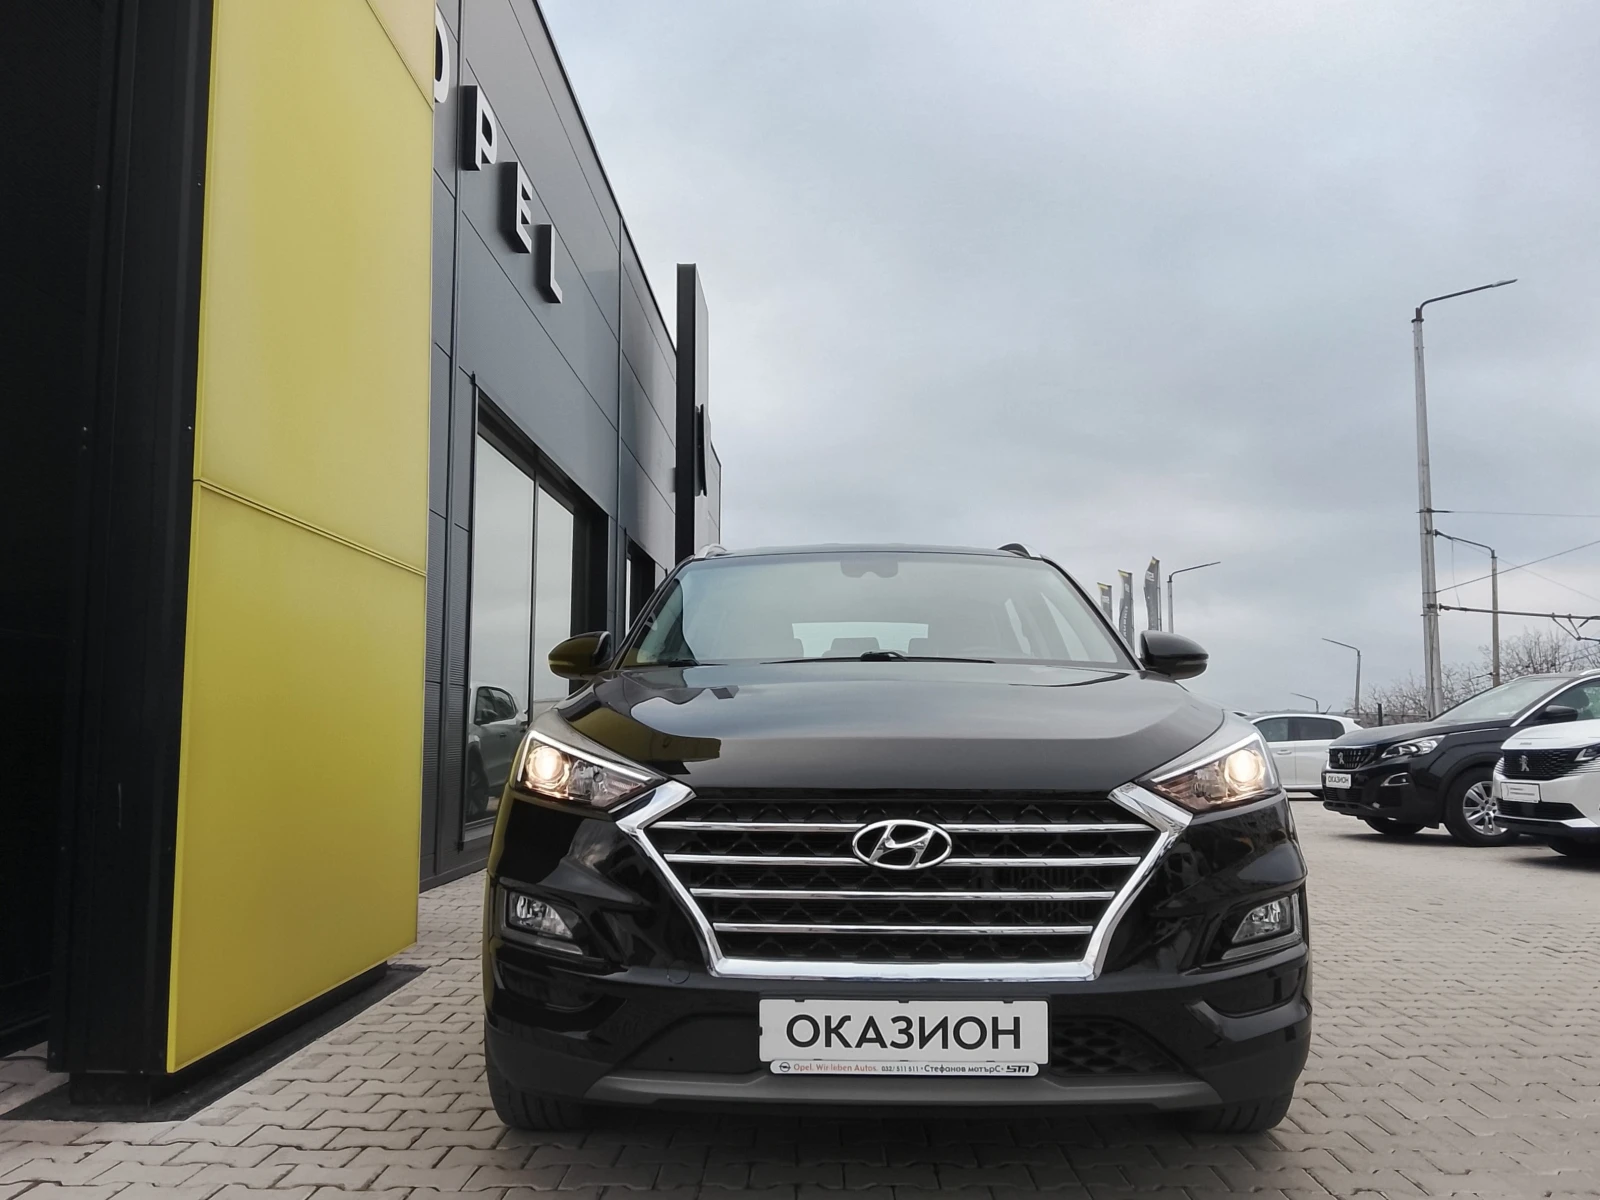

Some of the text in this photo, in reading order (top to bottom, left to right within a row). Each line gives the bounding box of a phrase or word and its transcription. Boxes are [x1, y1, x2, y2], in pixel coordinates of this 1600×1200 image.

[786, 1014, 1021, 1050] ОКАЗИОН
[816, 1063, 828, 1072] Wir
[830, 1063, 853, 1072] leben
[924, 1064, 966, 1074] Стефанов
